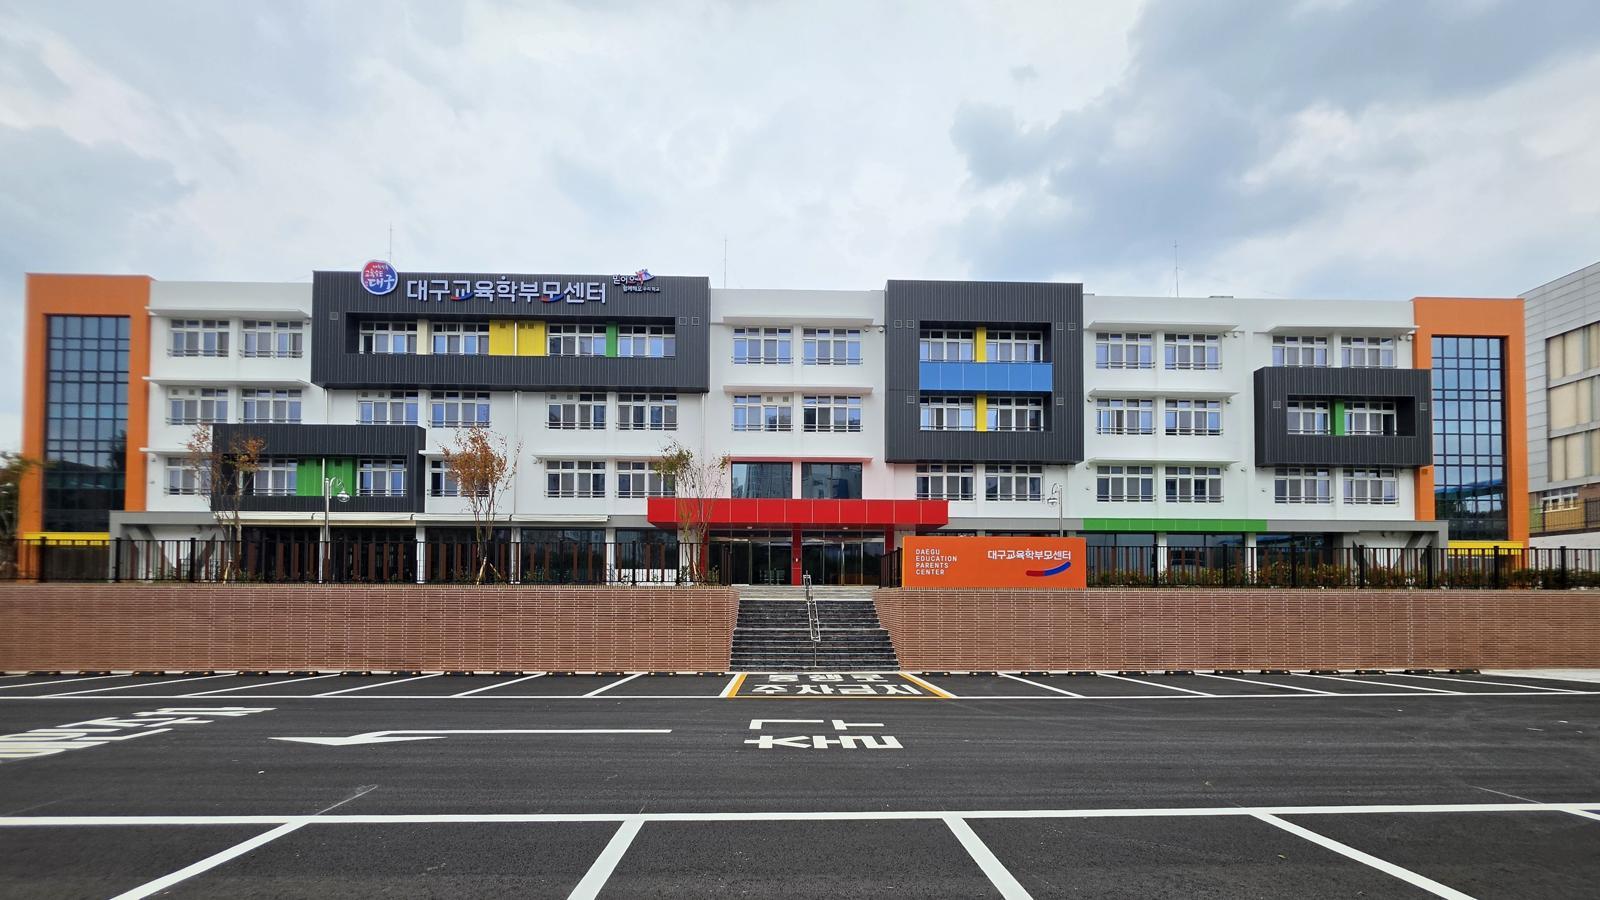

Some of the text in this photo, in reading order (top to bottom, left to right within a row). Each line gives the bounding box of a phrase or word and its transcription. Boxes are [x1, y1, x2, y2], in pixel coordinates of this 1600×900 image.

[367, 274, 395, 290] 대구
[407, 275, 606, 303] 대구교육학부모센터
[987, 548, 1072, 561] 대구교육학부모센터
[752, 684, 923, 695] 주차금지
